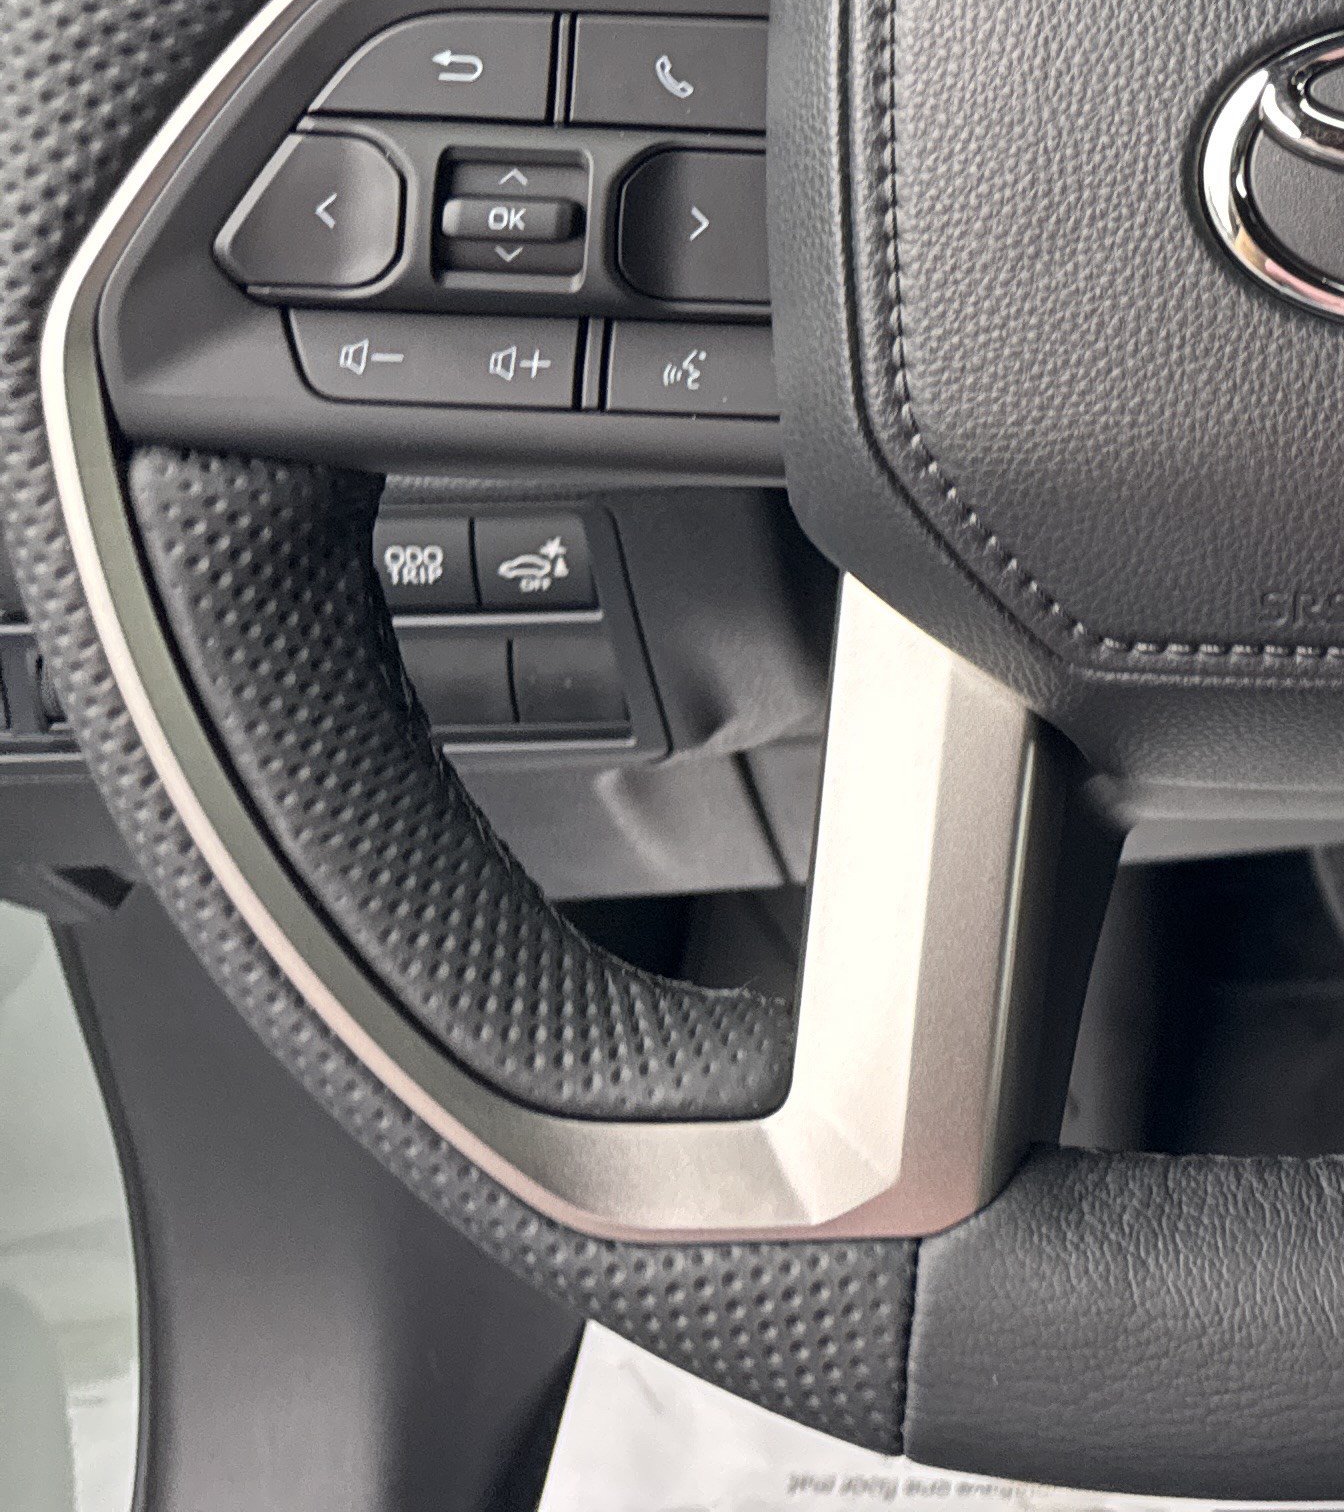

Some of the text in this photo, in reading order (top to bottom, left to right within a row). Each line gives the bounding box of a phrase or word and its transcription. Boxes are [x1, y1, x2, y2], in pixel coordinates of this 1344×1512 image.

[487, 207, 527, 231] OK
[384, 545, 444, 568] ODO
[387, 564, 443, 586] TRIP
